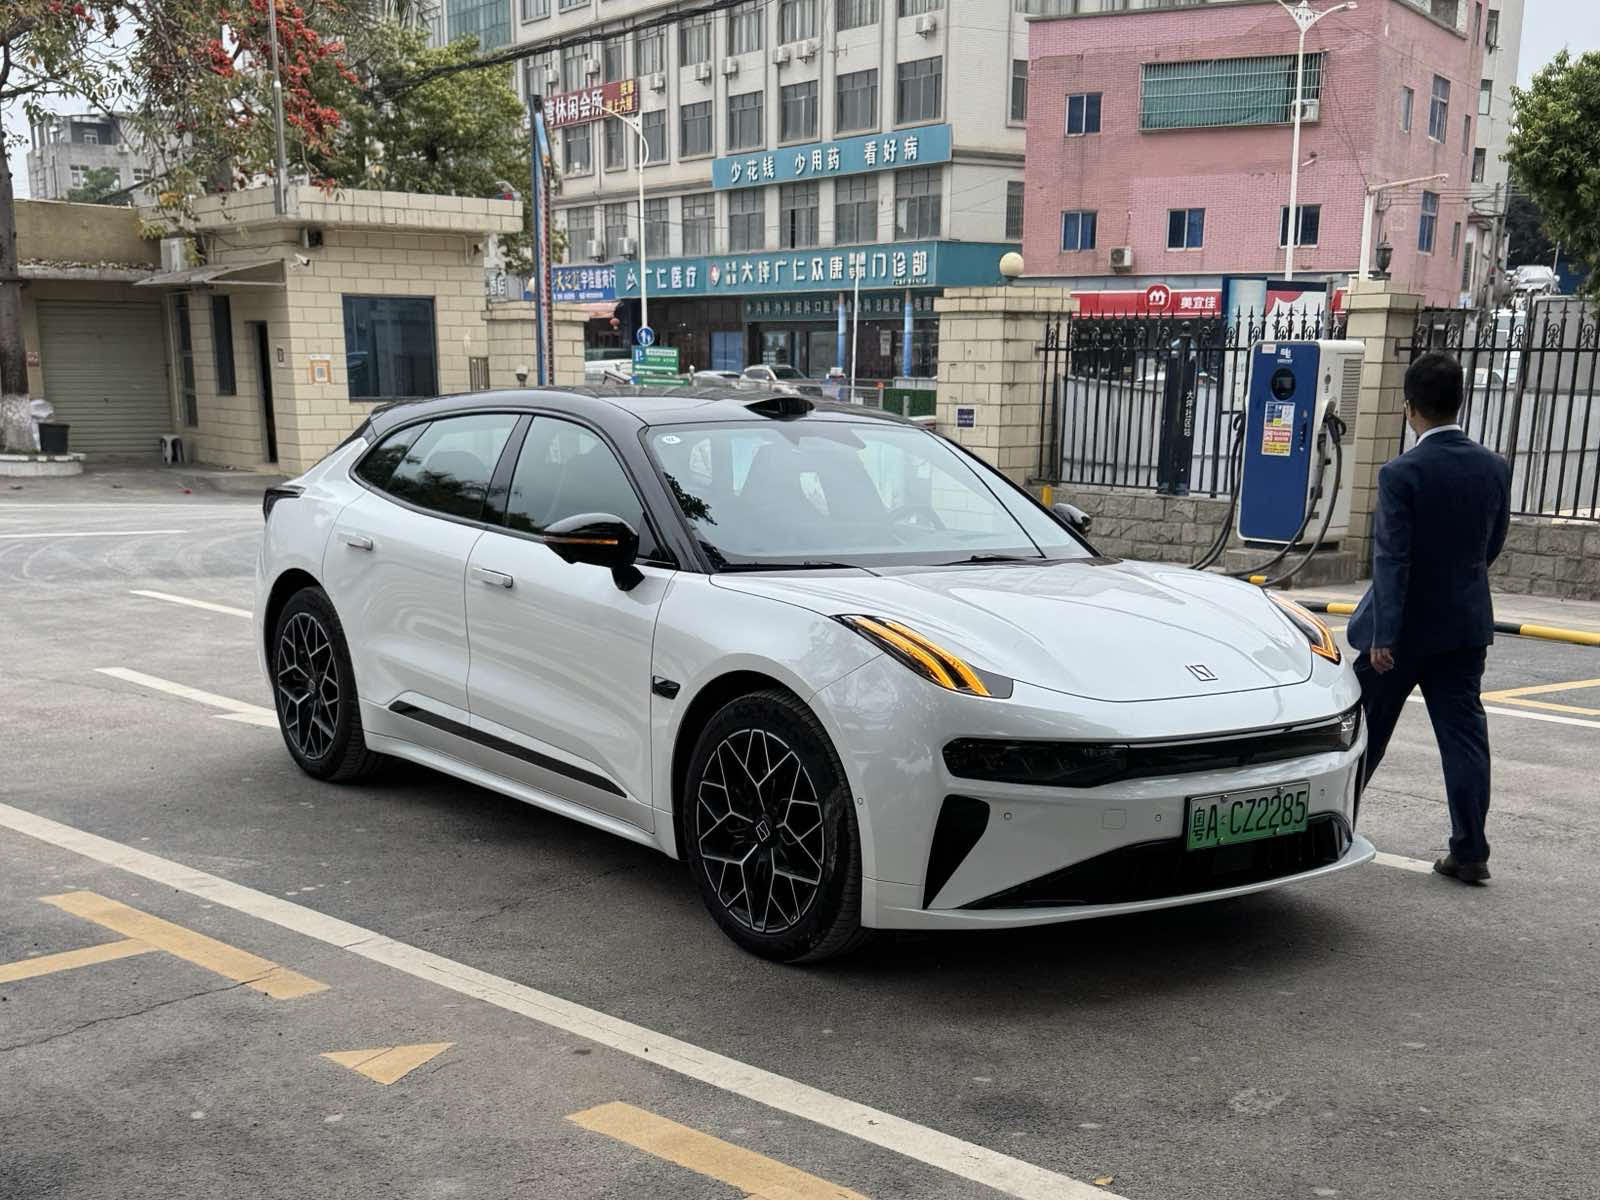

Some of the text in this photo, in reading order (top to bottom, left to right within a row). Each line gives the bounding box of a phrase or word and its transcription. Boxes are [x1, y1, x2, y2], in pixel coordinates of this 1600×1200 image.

[731, 136, 920, 183] 少花钱 少用药 看好病
[741, 255, 843, 284] 大坪广仁众康
[872, 250, 928, 278] 门诊部
[1181, 296, 1216, 309] 美宜佳
[1193, 791, 1307, 841] 粤A CZ2285
